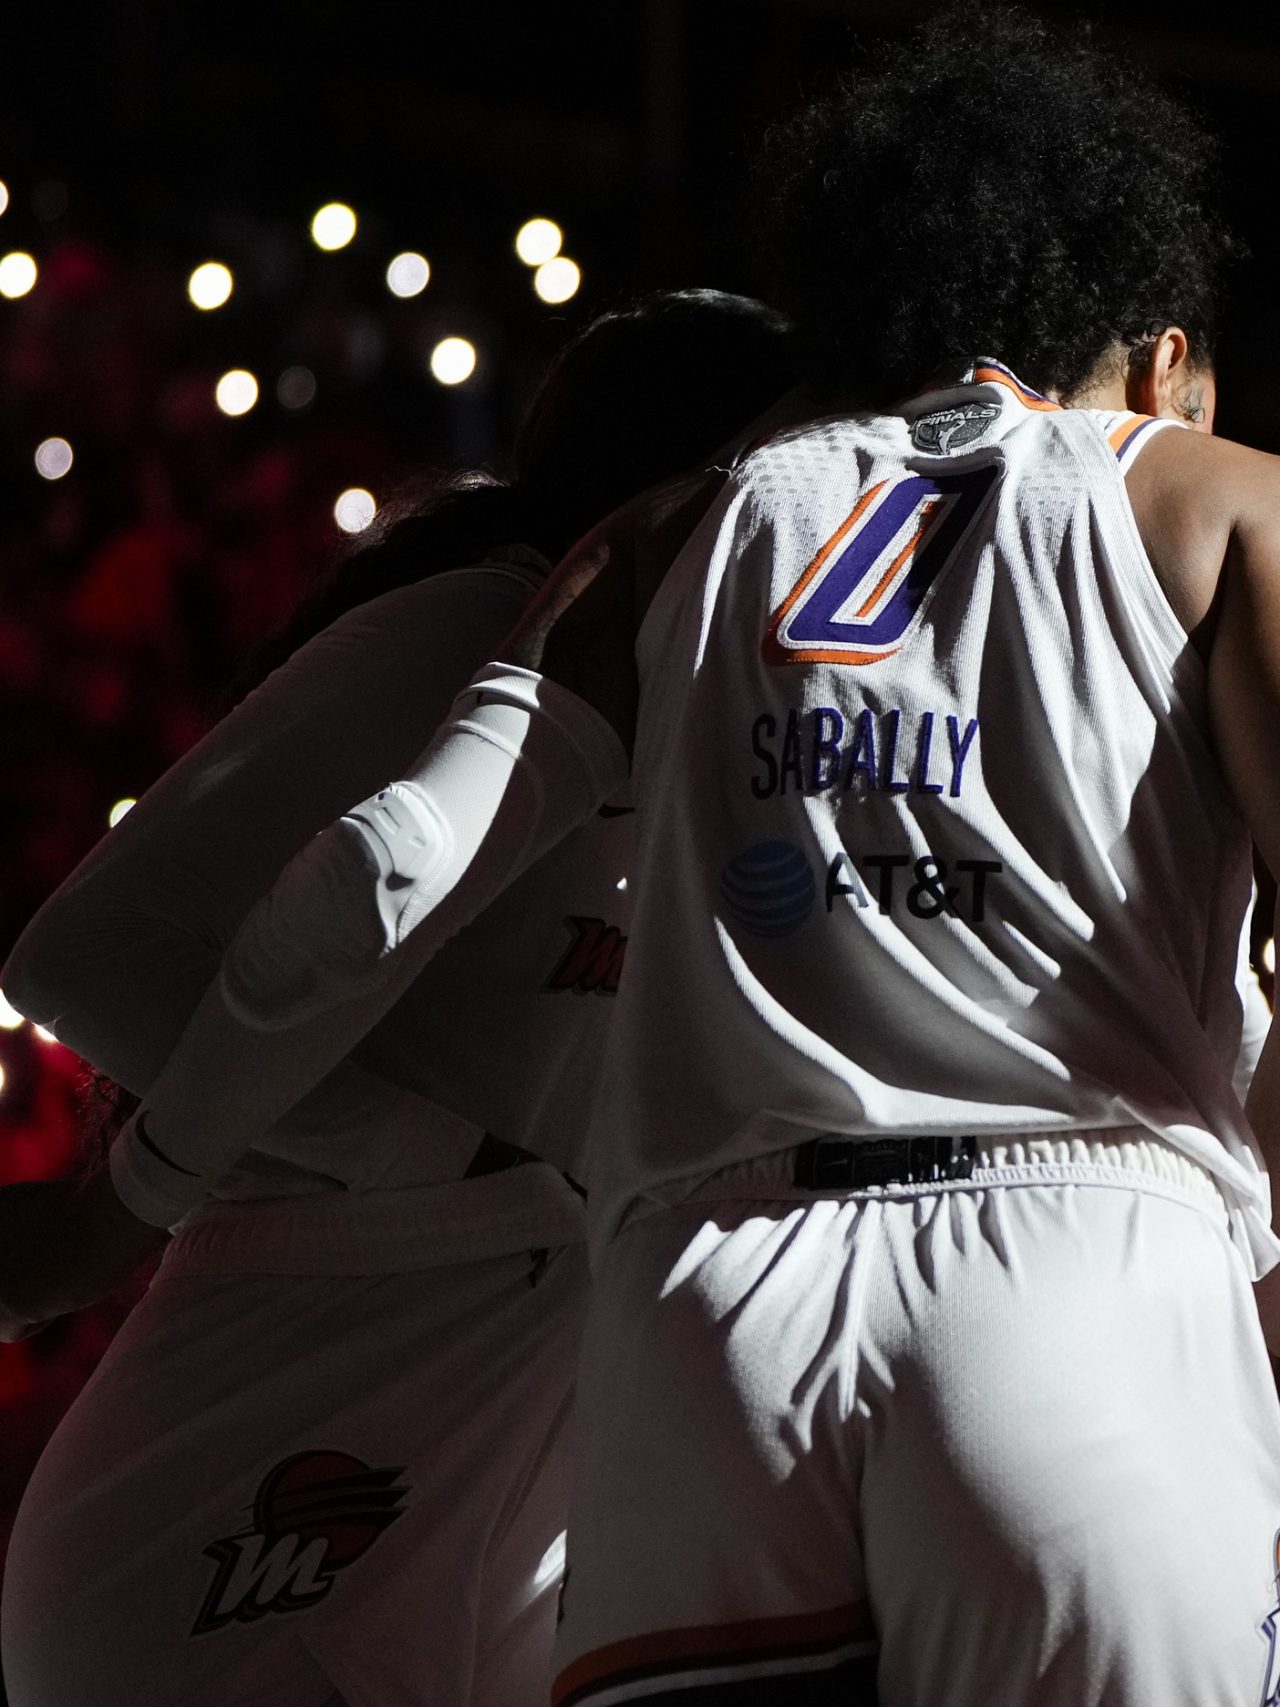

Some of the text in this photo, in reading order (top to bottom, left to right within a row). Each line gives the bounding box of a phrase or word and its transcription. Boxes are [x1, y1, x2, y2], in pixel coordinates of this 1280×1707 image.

[917, 409, 997, 428] FINALS
[761, 457, 1007, 666] 0
[751, 706, 980, 799] SABALLY
[825, 853, 1002, 922] AT&T
